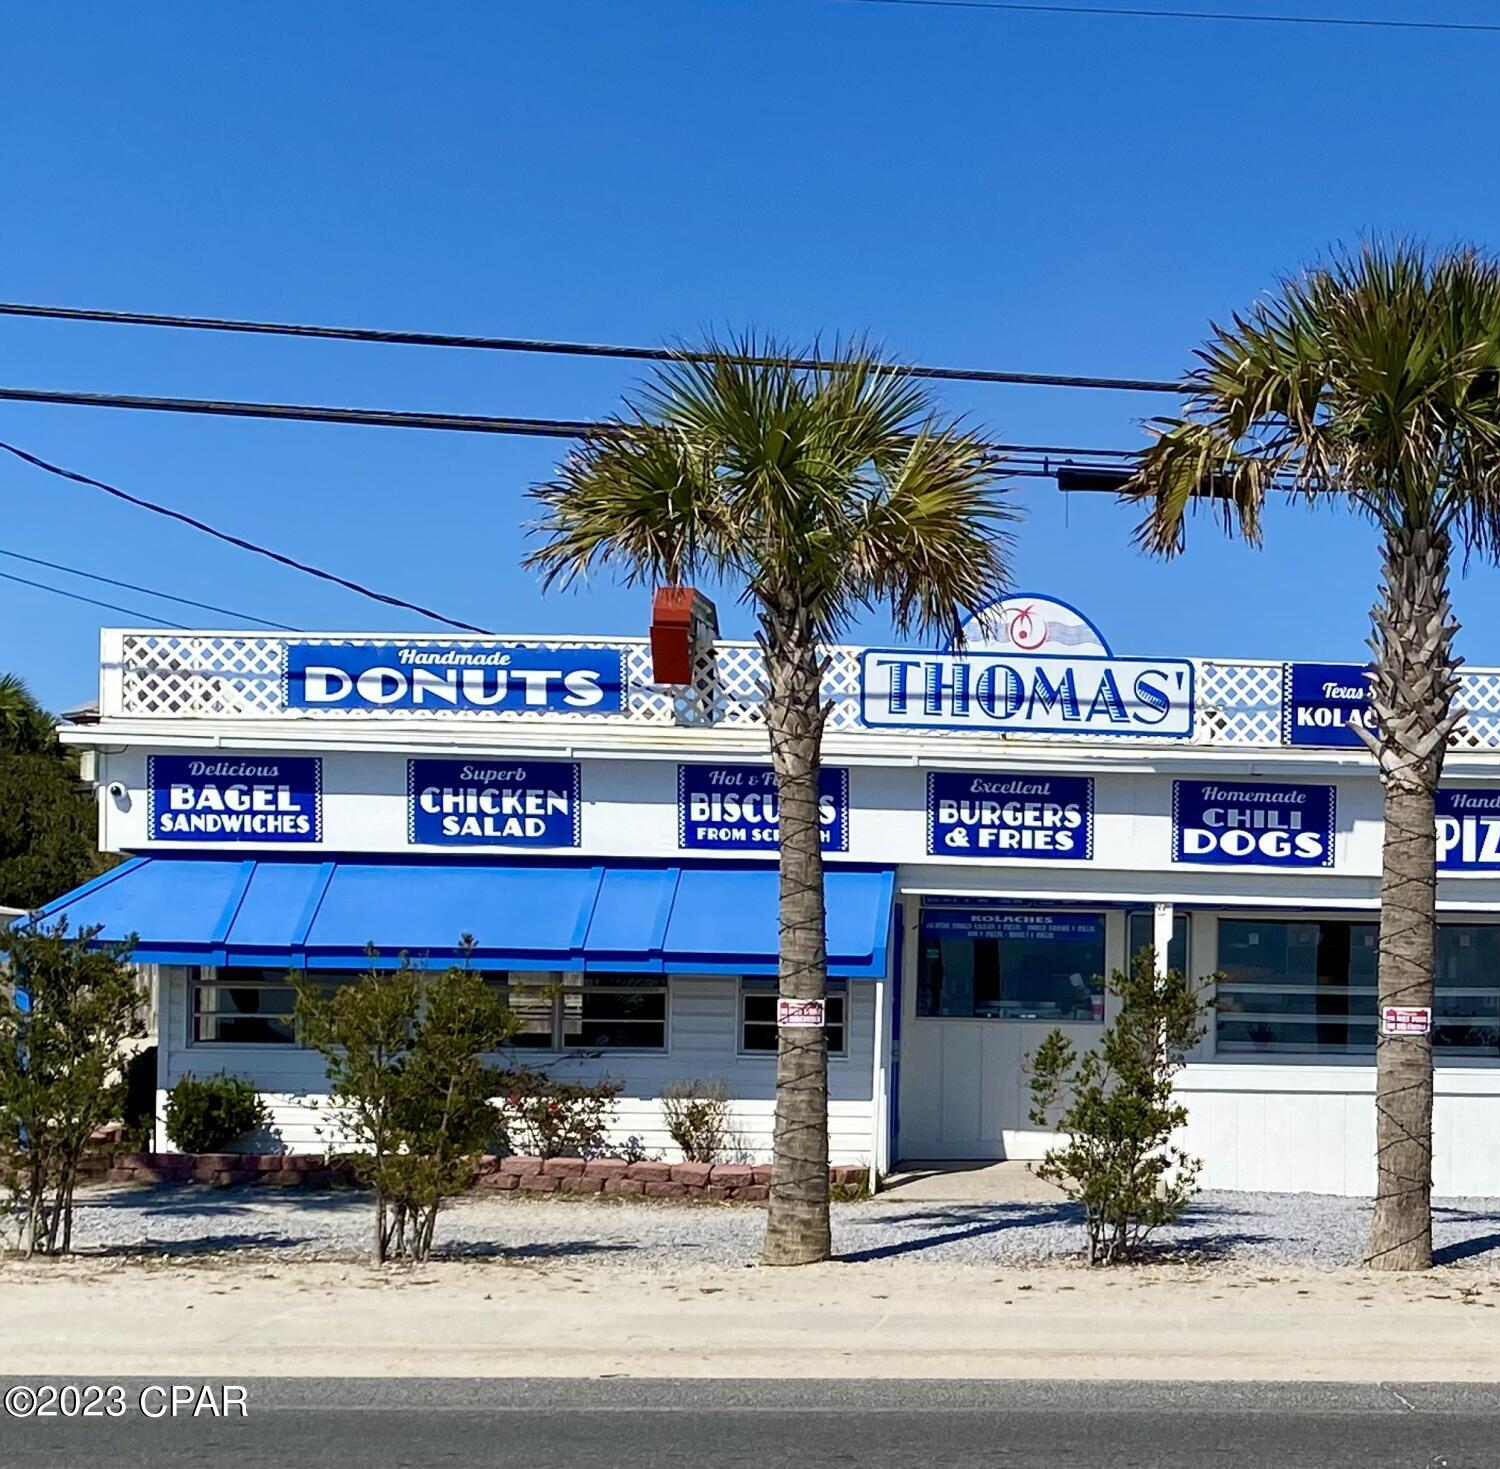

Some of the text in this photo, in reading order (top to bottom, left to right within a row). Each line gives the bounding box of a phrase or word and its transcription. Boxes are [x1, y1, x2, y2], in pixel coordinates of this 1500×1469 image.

[399, 648, 512, 666] Handmade
[304, 666, 604, 707] DONUTS
[877, 659, 1184, 725] THOMAS'
[1322, 682, 1364, 699] Texas
[1297, 706, 1378, 729] KOLAC
[189, 761, 280, 778] Delicious
[460, 766, 527, 784] Superb
[709, 770, 744, 786] Hot
[748, 775, 760, 786] &
[970, 777, 1052, 796] Excellent
[1201, 786, 1307, 804] Homemade
[171, 784, 302, 812] BAGEL
[420, 787, 570, 816] CHICKEN
[690, 792, 837, 825] BISCUS
[160, 814, 310, 834] SANDWICHES
[938, 799, 1082, 829] BURGERS
[1202, 807, 1302, 830] CHILI
[442, 816, 547, 838] SALAD
[697, 827, 747, 841] FROM
[945, 828, 1075, 851] & FRIES
[1183, 828, 1324, 859] DOGS
[970, 914, 1053, 924] KOLACHES
